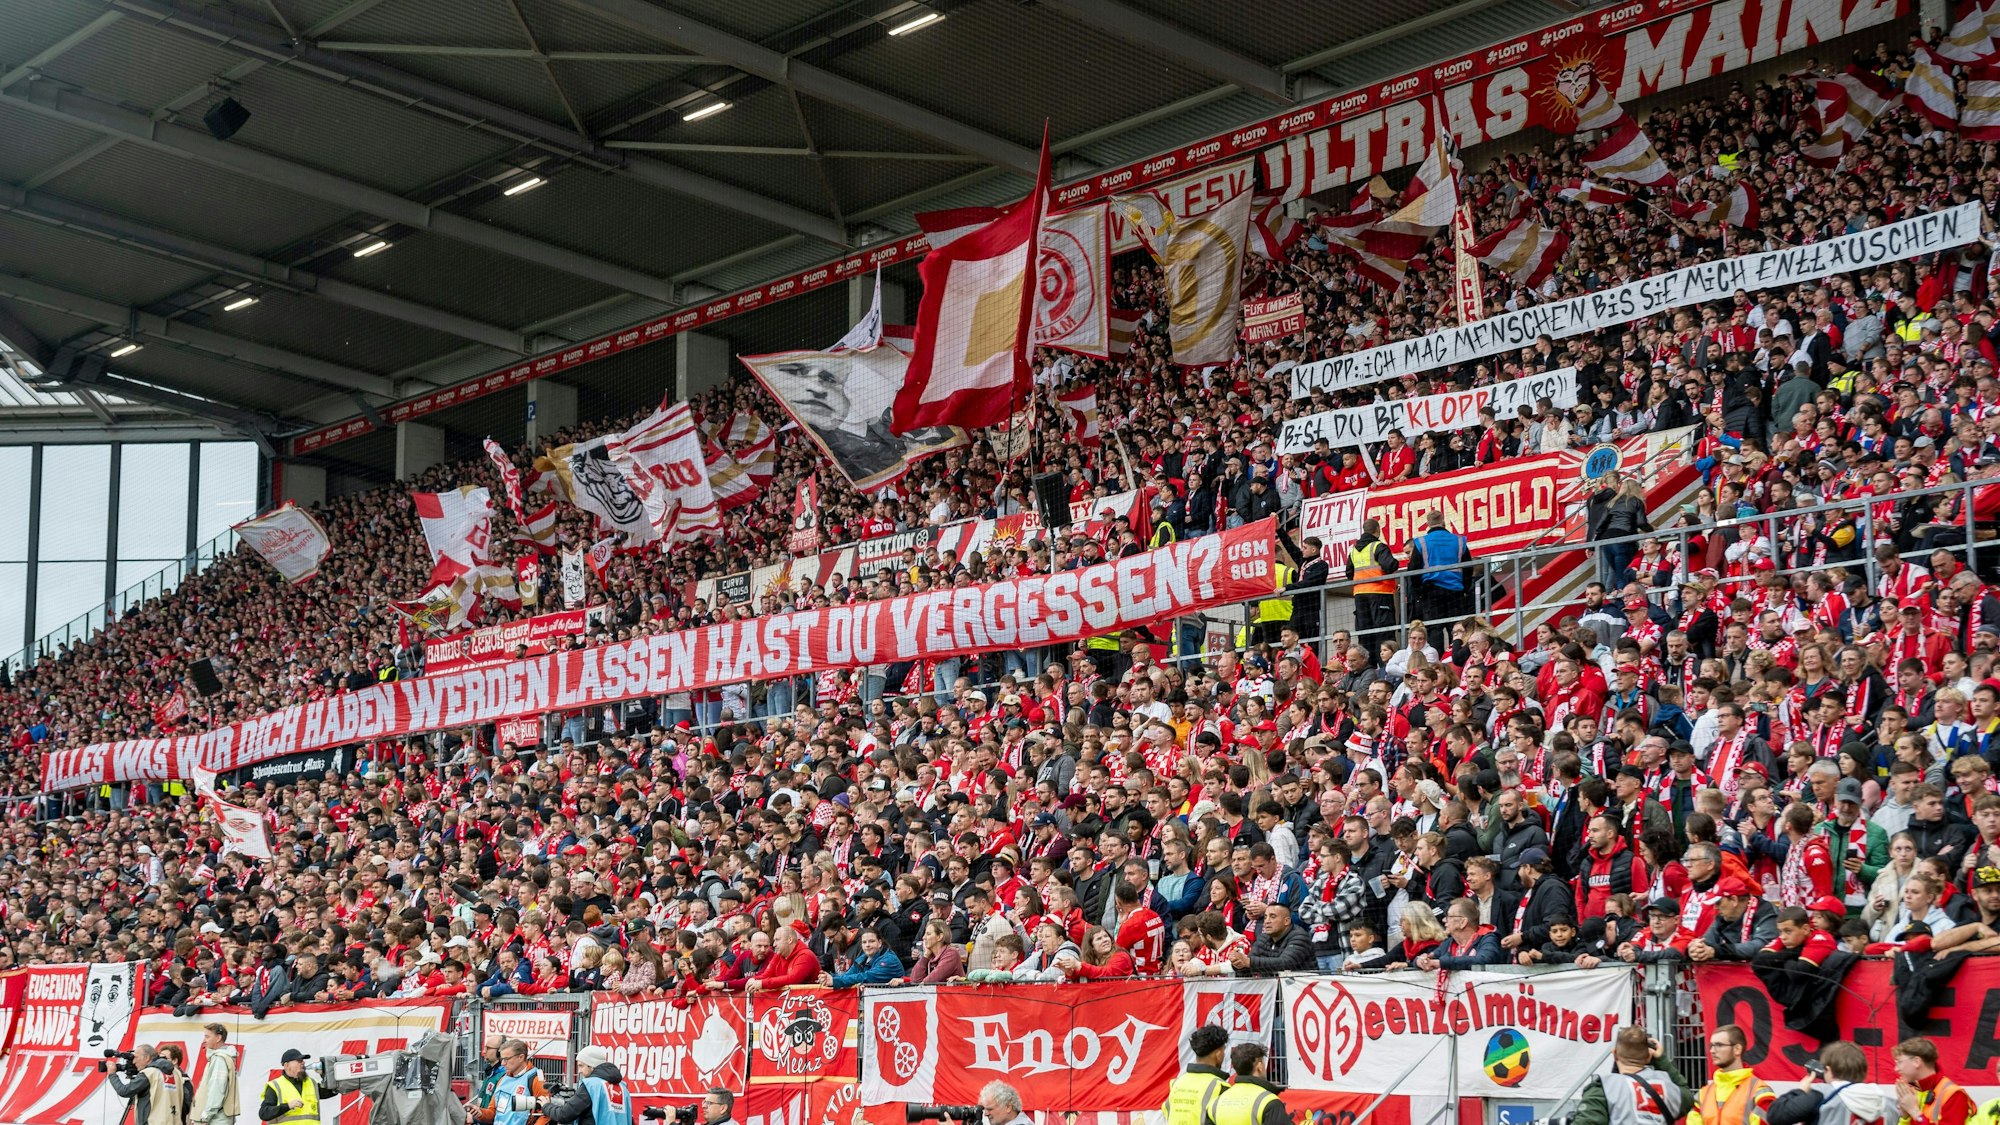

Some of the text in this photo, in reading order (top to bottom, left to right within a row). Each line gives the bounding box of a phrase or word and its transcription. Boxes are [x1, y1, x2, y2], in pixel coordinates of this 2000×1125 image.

[1611, 3, 1644, 23] LOTTO
[1552, 23, 1584, 41] LOTTO
[1497, 41, 1528, 59] LOTTO
[1442, 59, 1473, 77] LOTTO
[1390, 77, 1419, 93] LOTTO
[1340, 93, 1368, 110] LOTTO
[1288, 110, 1315, 127] LOTTO
[1241, 126, 1267, 142] LOTTO
[1264, 67, 1529, 204] ULTRAS
[1195, 141, 1221, 157] LOTTO
[1151, 157, 1176, 172] LOTTO
[1109, 171, 1132, 185] LOTTO
[1067, 184, 1090, 198] LOTTO
[913, 236, 930, 249] LOTT
[877, 247, 897, 260] LOTTO
[809, 269, 827, 282] LOTTO
[776, 280, 794, 293] LOTTO
[744, 291, 762, 304] LOTTO
[713, 301, 730, 313] LOTTO
[681, 311, 697, 323] LOTTO
[1249, 320, 1280, 341] MAINZ
[1404, 334, 1447, 370] MAG
[1306, 498, 1360, 530] ZITTY
[858, 532, 916, 560] SEKTION
[1228, 538, 1268, 562] USM
[1230, 557, 1268, 581] SUB
[722, 577, 744, 590] CURVA
[44, 532, 1222, 791] ALLES WAS WIR DICH HABEN WERDEN LASSEN HAST DU VERGESSEN?
[28, 973, 83, 1000] EUGENIOS
[23, 1005, 77, 1047] BANDE
[488, 1018, 566, 1036] SUBURBIA
[957, 1012, 1170, 1085] Enoy
